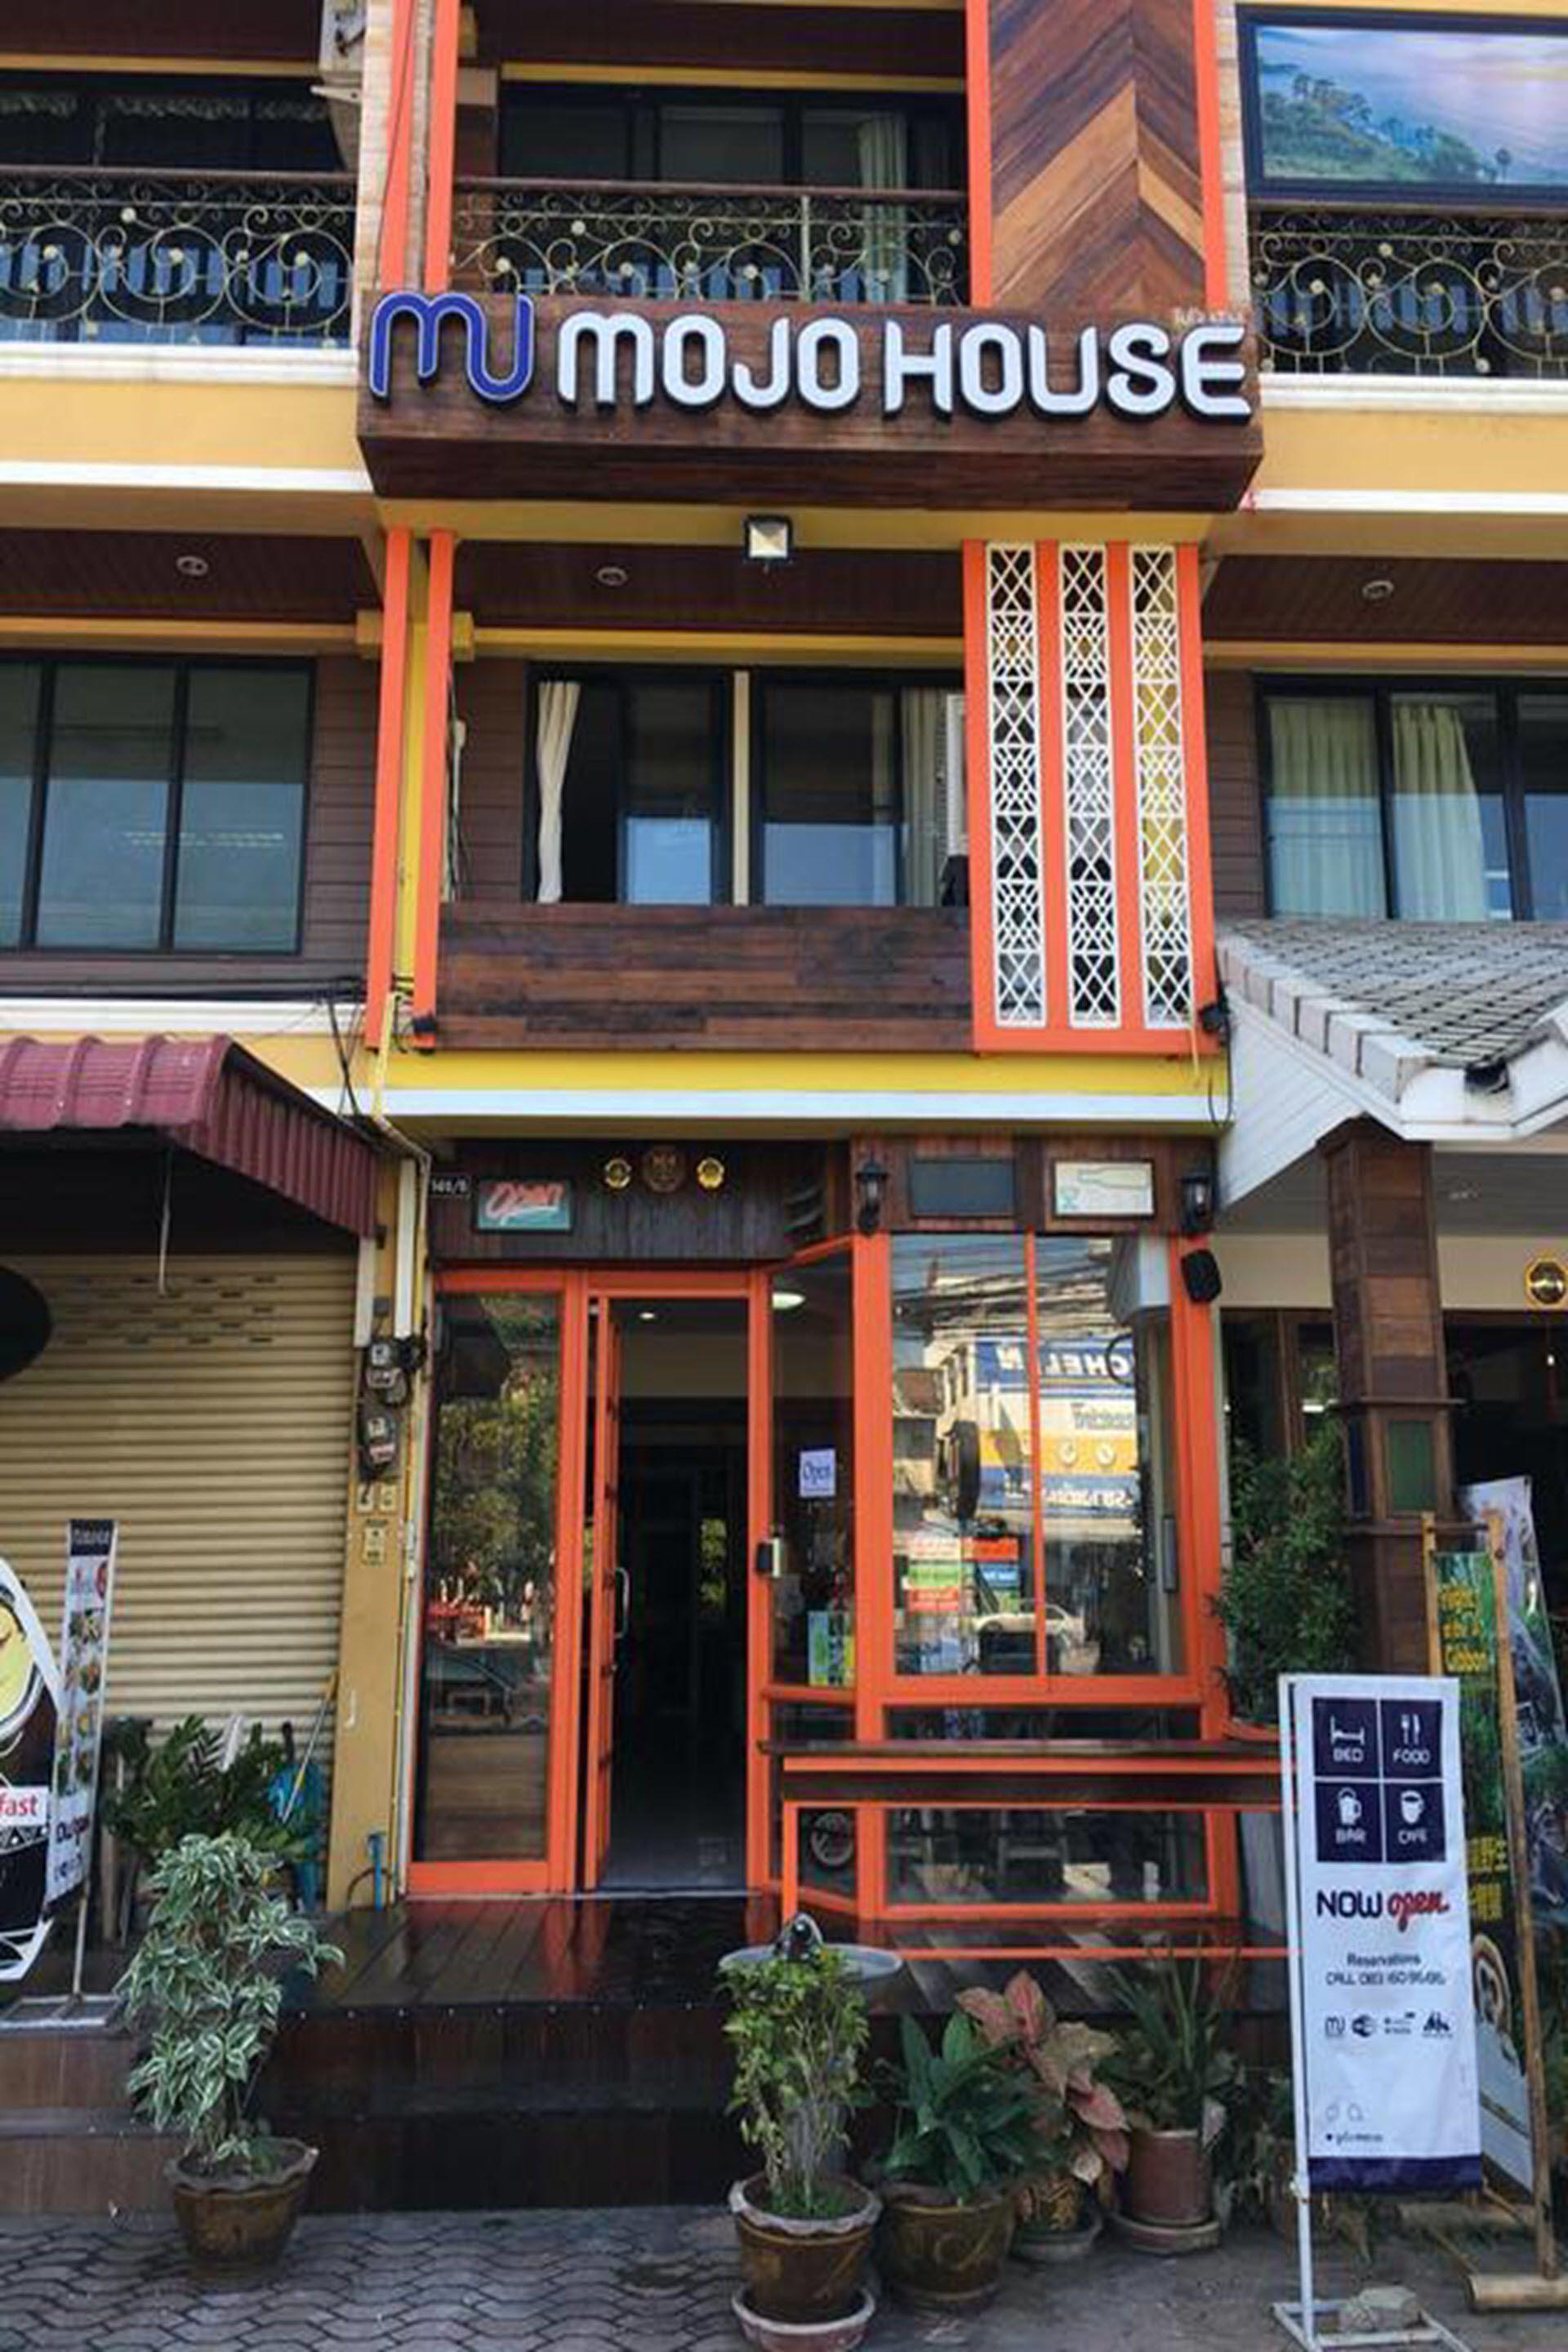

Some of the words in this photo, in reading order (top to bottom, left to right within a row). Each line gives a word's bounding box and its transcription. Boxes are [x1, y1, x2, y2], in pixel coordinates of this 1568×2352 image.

[557, 312, 860, 413] MOJO
[884, 321, 1252, 421] HOUSE
[1333, 1748, 1364, 1762] BED
[1393, 1748, 1430, 1764] FOOD
[1335, 1829, 1366, 1844] BAR
[1316, 1891, 1383, 1918] NOW
